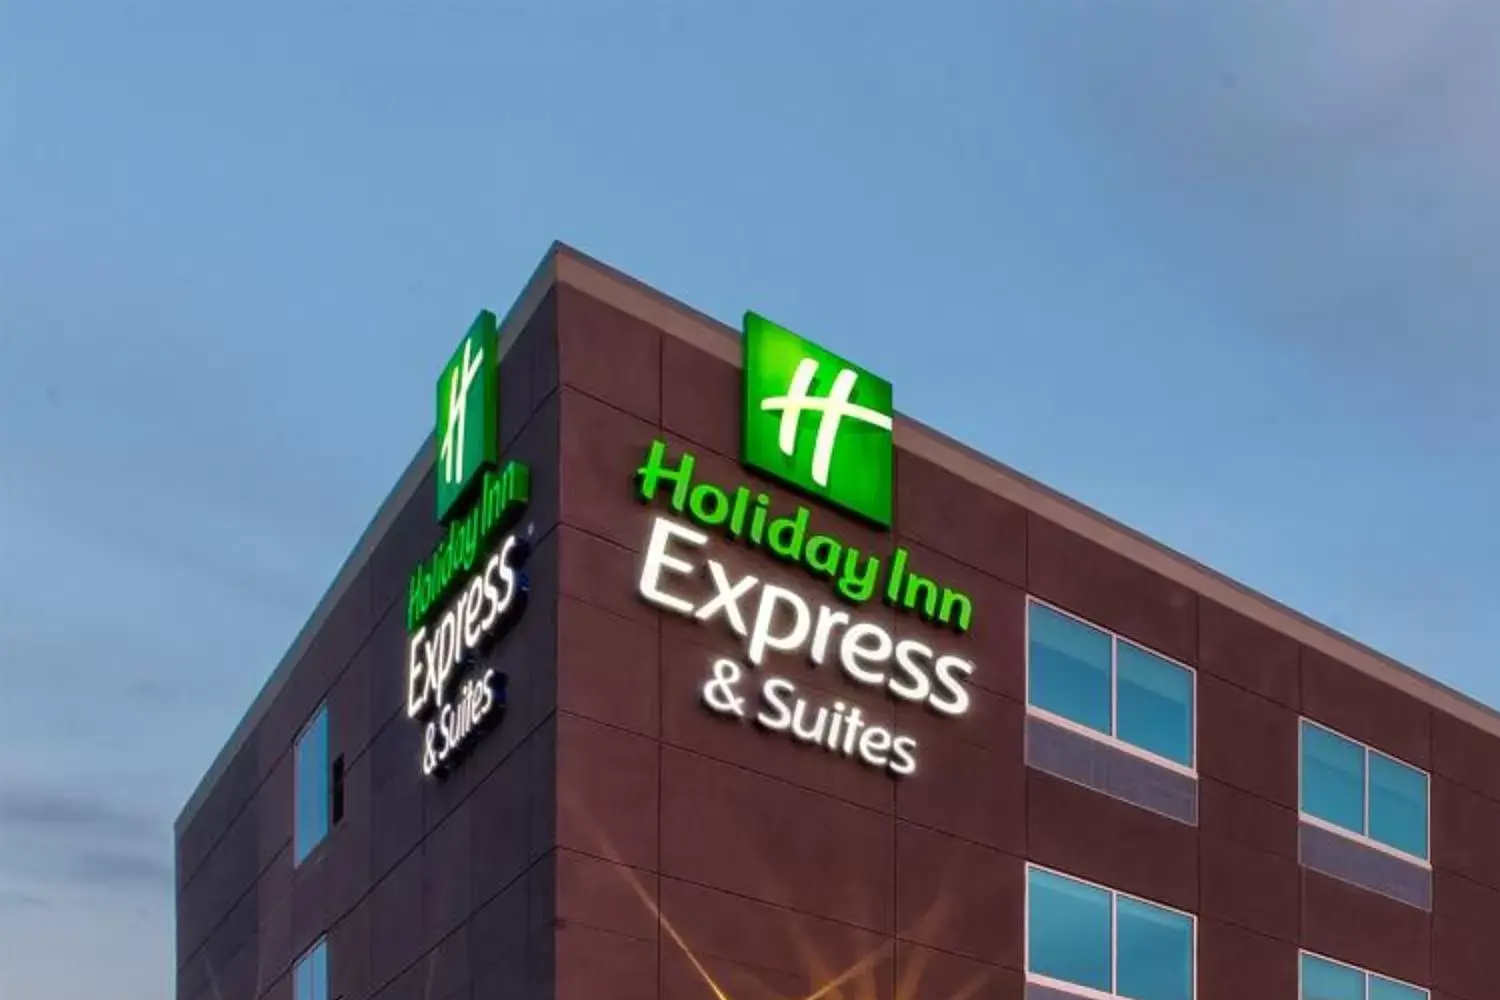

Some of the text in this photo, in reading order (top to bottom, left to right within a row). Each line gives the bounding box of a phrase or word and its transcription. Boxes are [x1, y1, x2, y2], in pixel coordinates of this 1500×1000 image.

[760, 357, 893, 487] H
[407, 460, 522, 632] Holiday Inn
[637, 440, 973, 631] Holiday Inn
[639, 516, 974, 715] Express
[407, 534, 517, 718] Express
[423, 668, 495, 775] & Suites
[703, 659, 917, 775] & Suites
